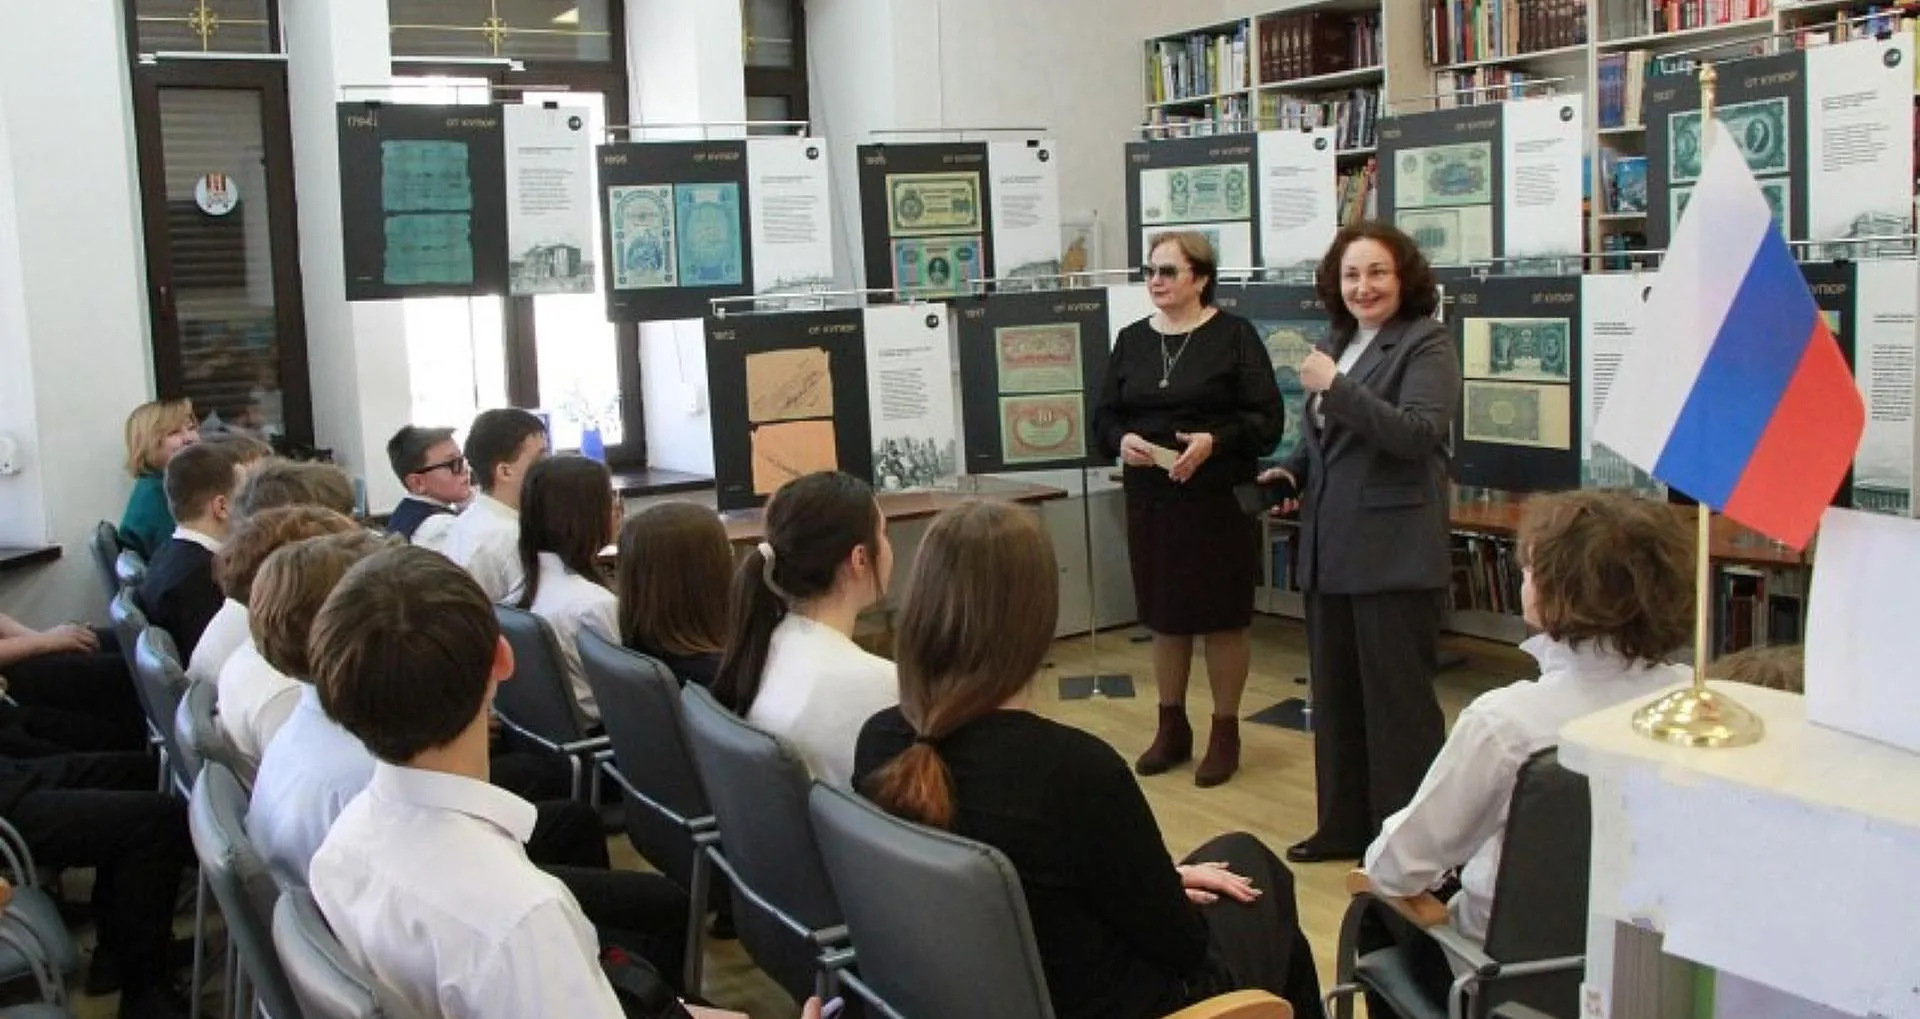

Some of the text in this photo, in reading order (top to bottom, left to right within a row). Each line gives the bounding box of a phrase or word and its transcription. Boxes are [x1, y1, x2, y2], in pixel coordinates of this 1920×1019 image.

[1744, 70, 1797, 88] ОТ КУПЮР
[1809, 283, 1847, 295] УПЮР
